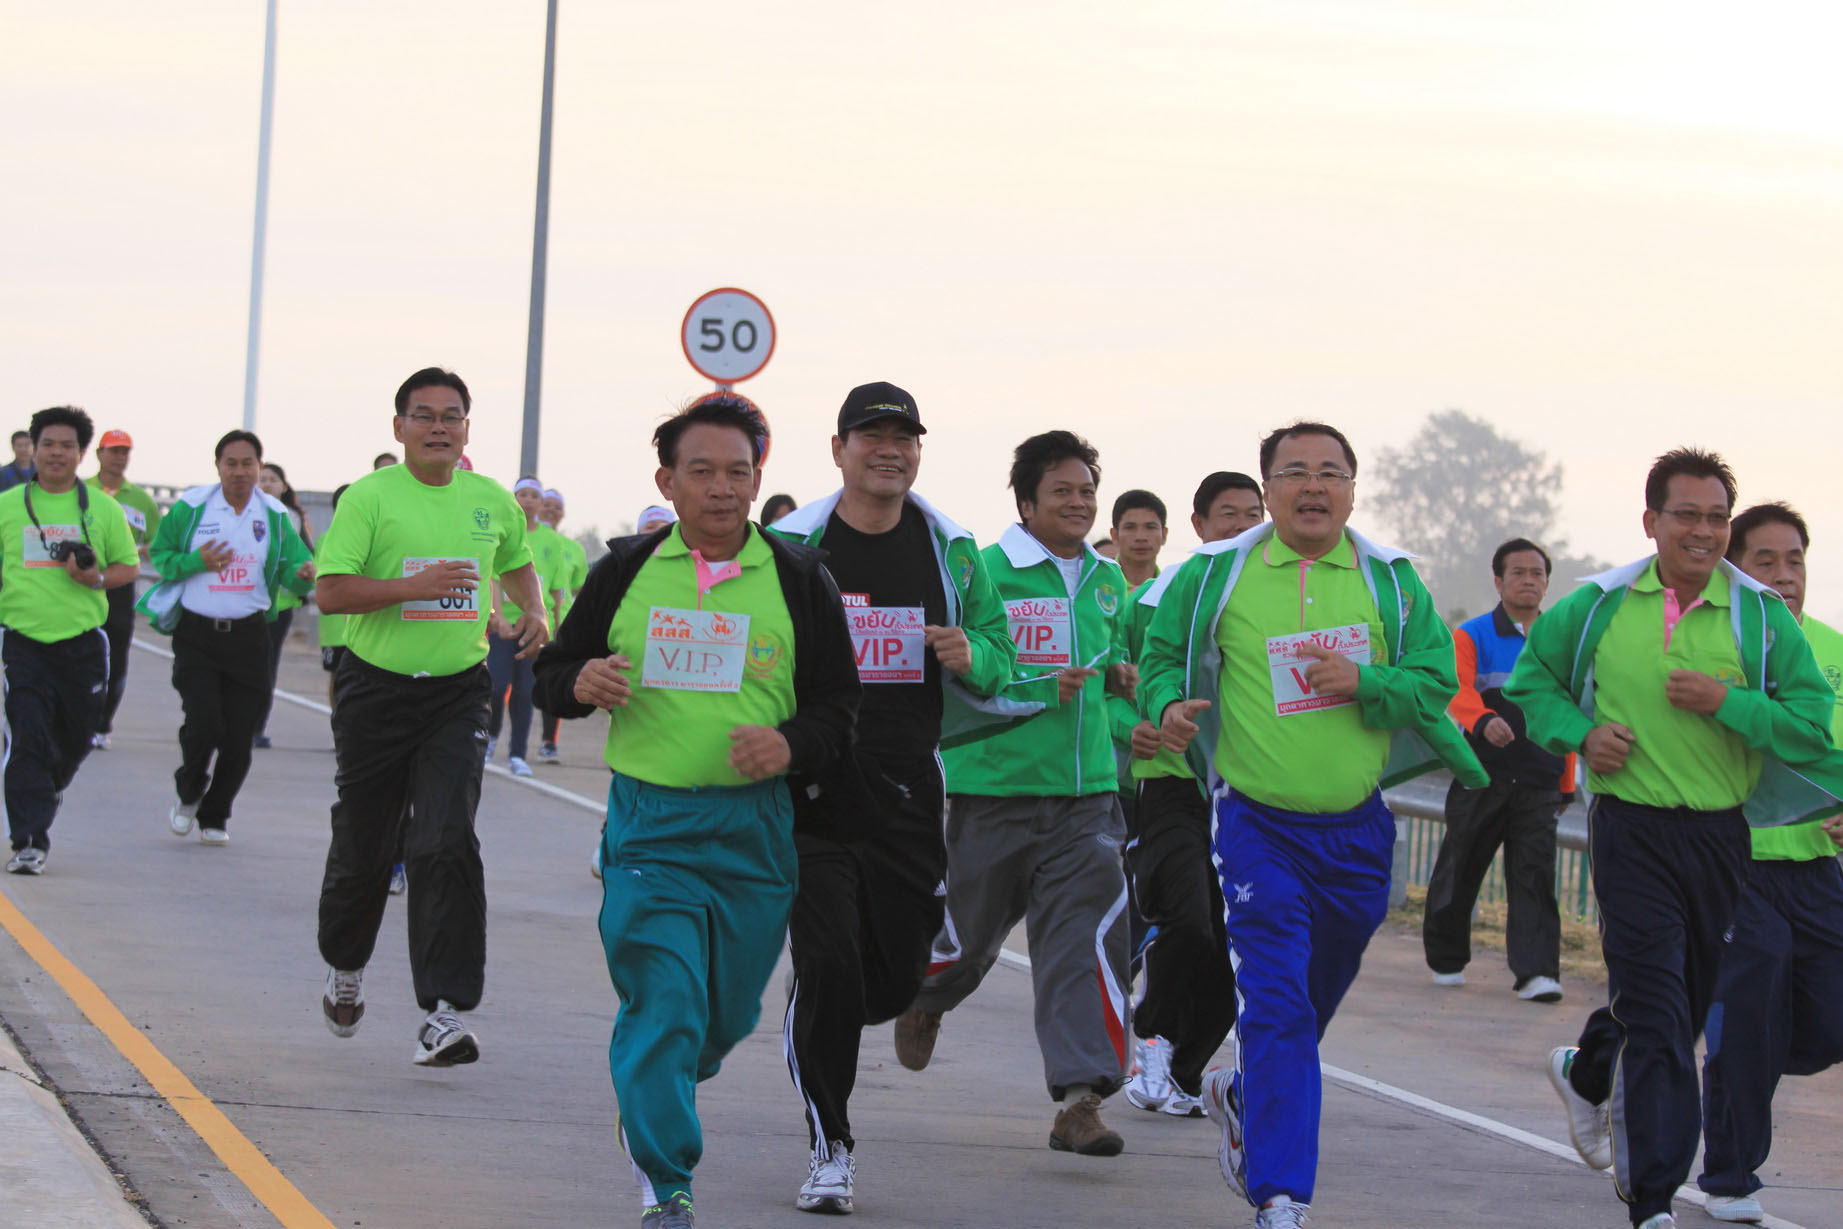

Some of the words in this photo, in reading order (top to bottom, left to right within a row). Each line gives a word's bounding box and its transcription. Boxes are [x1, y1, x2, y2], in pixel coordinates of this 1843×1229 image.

[700, 318, 758, 352] 50
[198, 528, 220, 536] POLICE
[1008, 601, 1046, 617] ขยับ
[853, 610, 896, 628] ขยับ
[658, 647, 724, 677] V.I.P.
